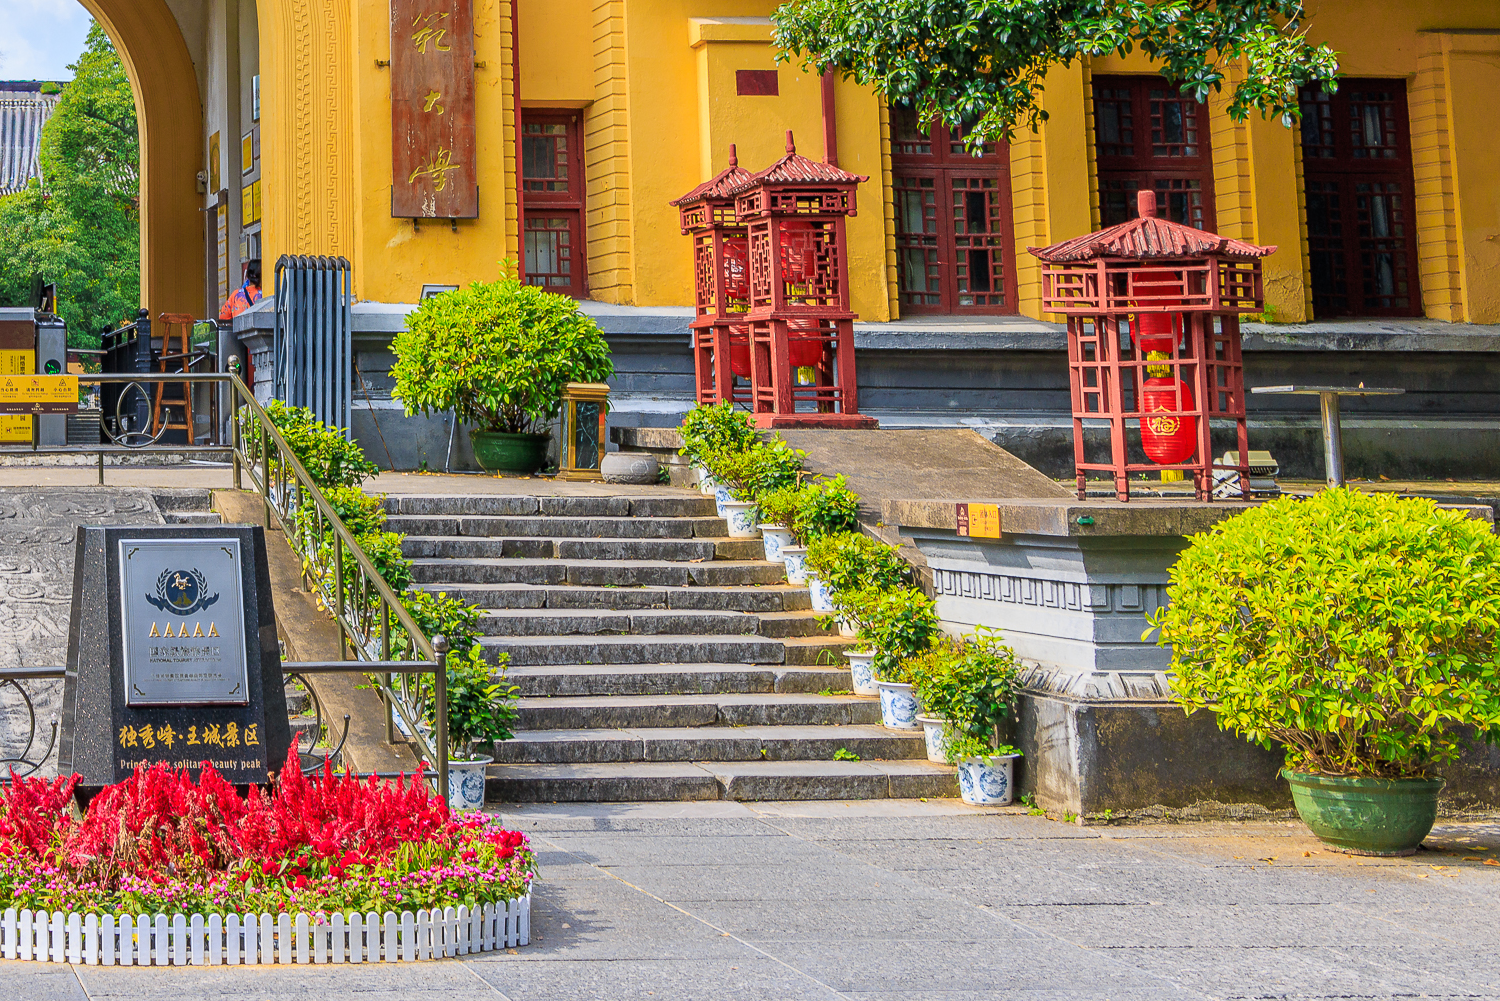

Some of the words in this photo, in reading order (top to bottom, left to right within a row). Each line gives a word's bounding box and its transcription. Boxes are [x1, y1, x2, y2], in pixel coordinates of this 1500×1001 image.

[148, 621, 221, 638] AAAAA
[119, 721, 260, 750] 独秀峰·王城景区
[174, 759, 204, 769] solitar
[210, 759, 237, 770] beauty
[241, 758, 261, 770] peak
